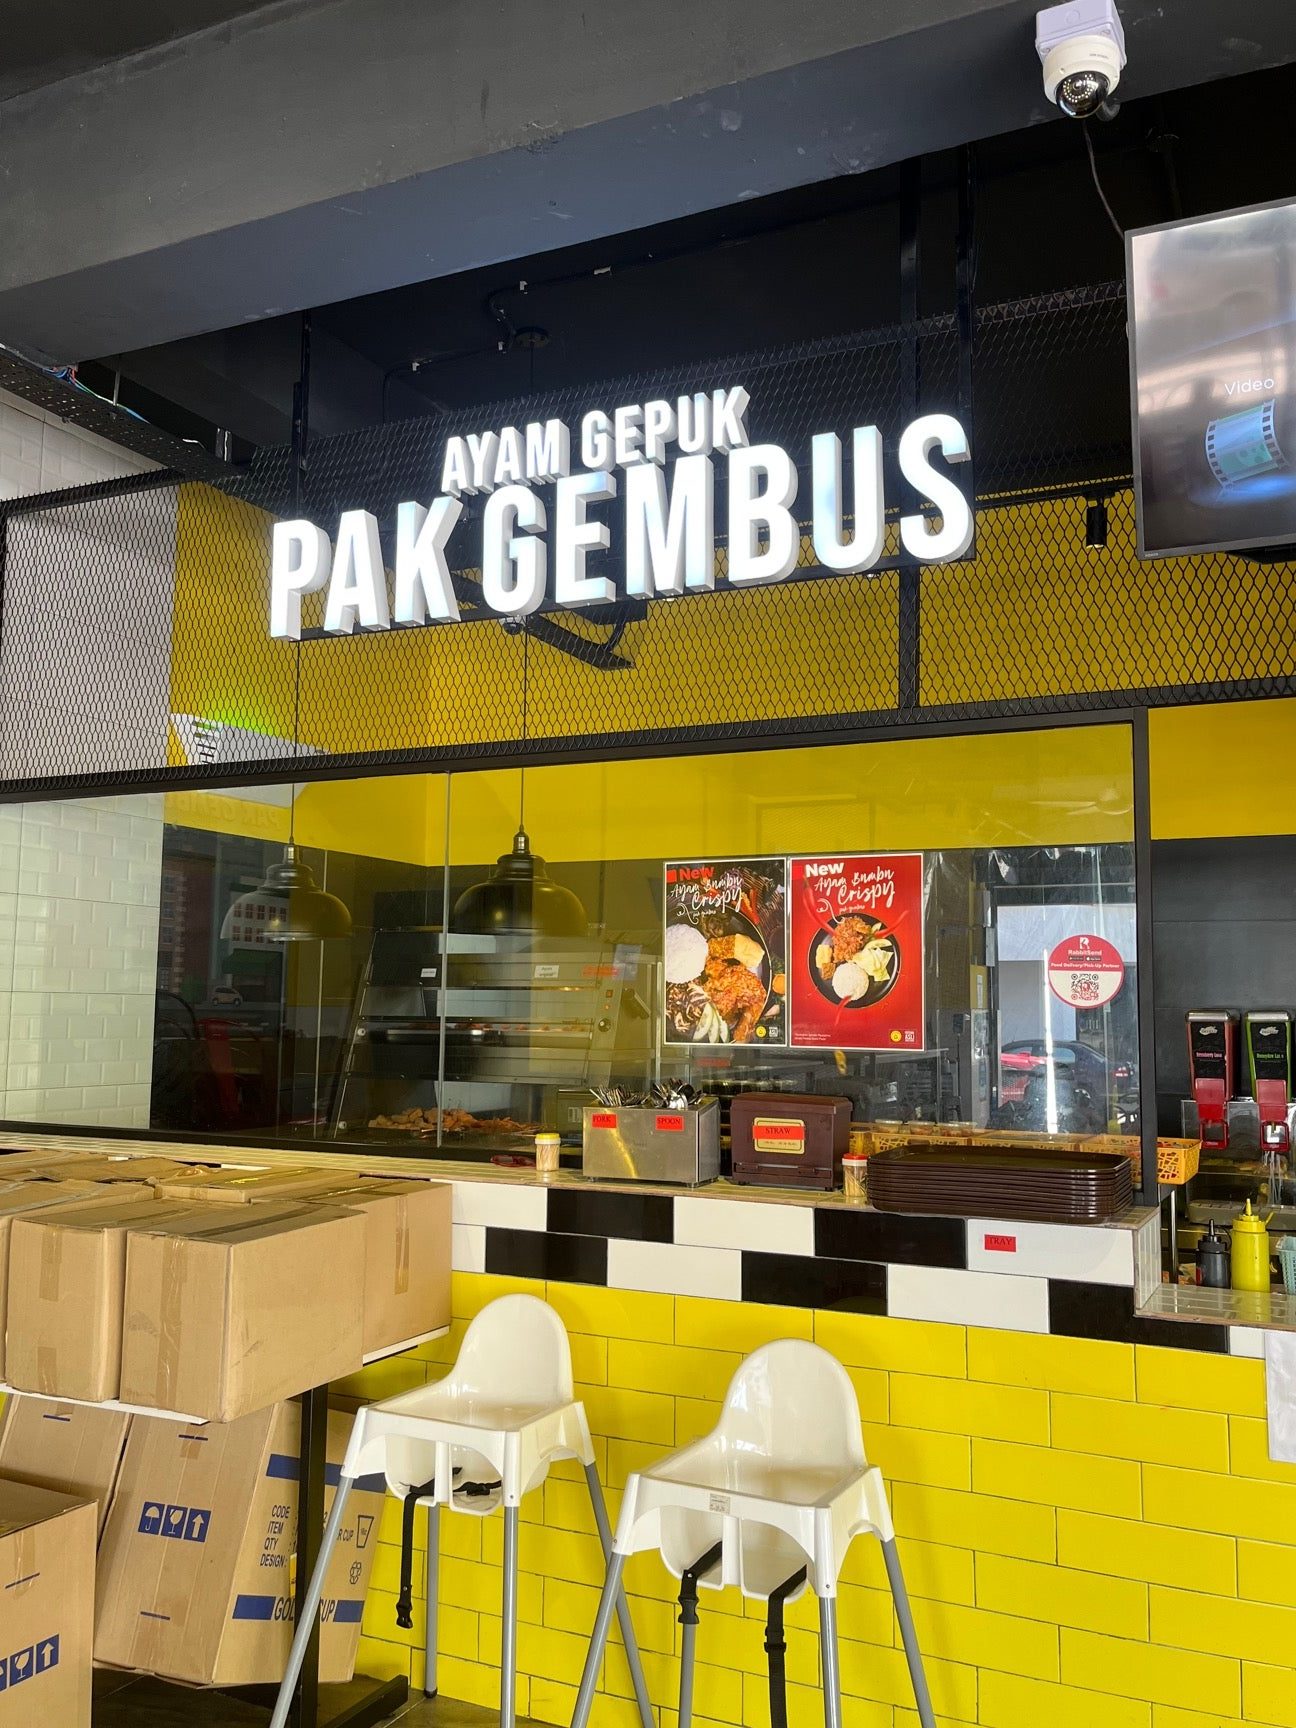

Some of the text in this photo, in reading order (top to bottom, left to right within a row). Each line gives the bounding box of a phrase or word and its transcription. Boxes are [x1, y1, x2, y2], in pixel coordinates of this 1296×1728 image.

[1224, 378, 1274, 395] Video
[441, 385, 749, 497] AYAM GEPUK
[271, 413, 974, 640] PAK GEMBUS
[680, 866, 714, 880] New
[805, 862, 844, 878] New
[814, 877, 847, 896] Ayam
[691, 888, 742, 913] Crispy
[838, 880, 895, 909] Crispy
[593, 1114, 611, 1123] FORK
[657, 1117, 681, 1125] SPOON
[765, 1127, 791, 1135] STRAW
[990, 1237, 1012, 1245] TRAY
[272, 1504, 291, 1519] CODE
[268, 1520, 284, 1535] ITEM
[343, 1529, 354, 1541] CUP
[264, 1538, 278, 1550] QTY
